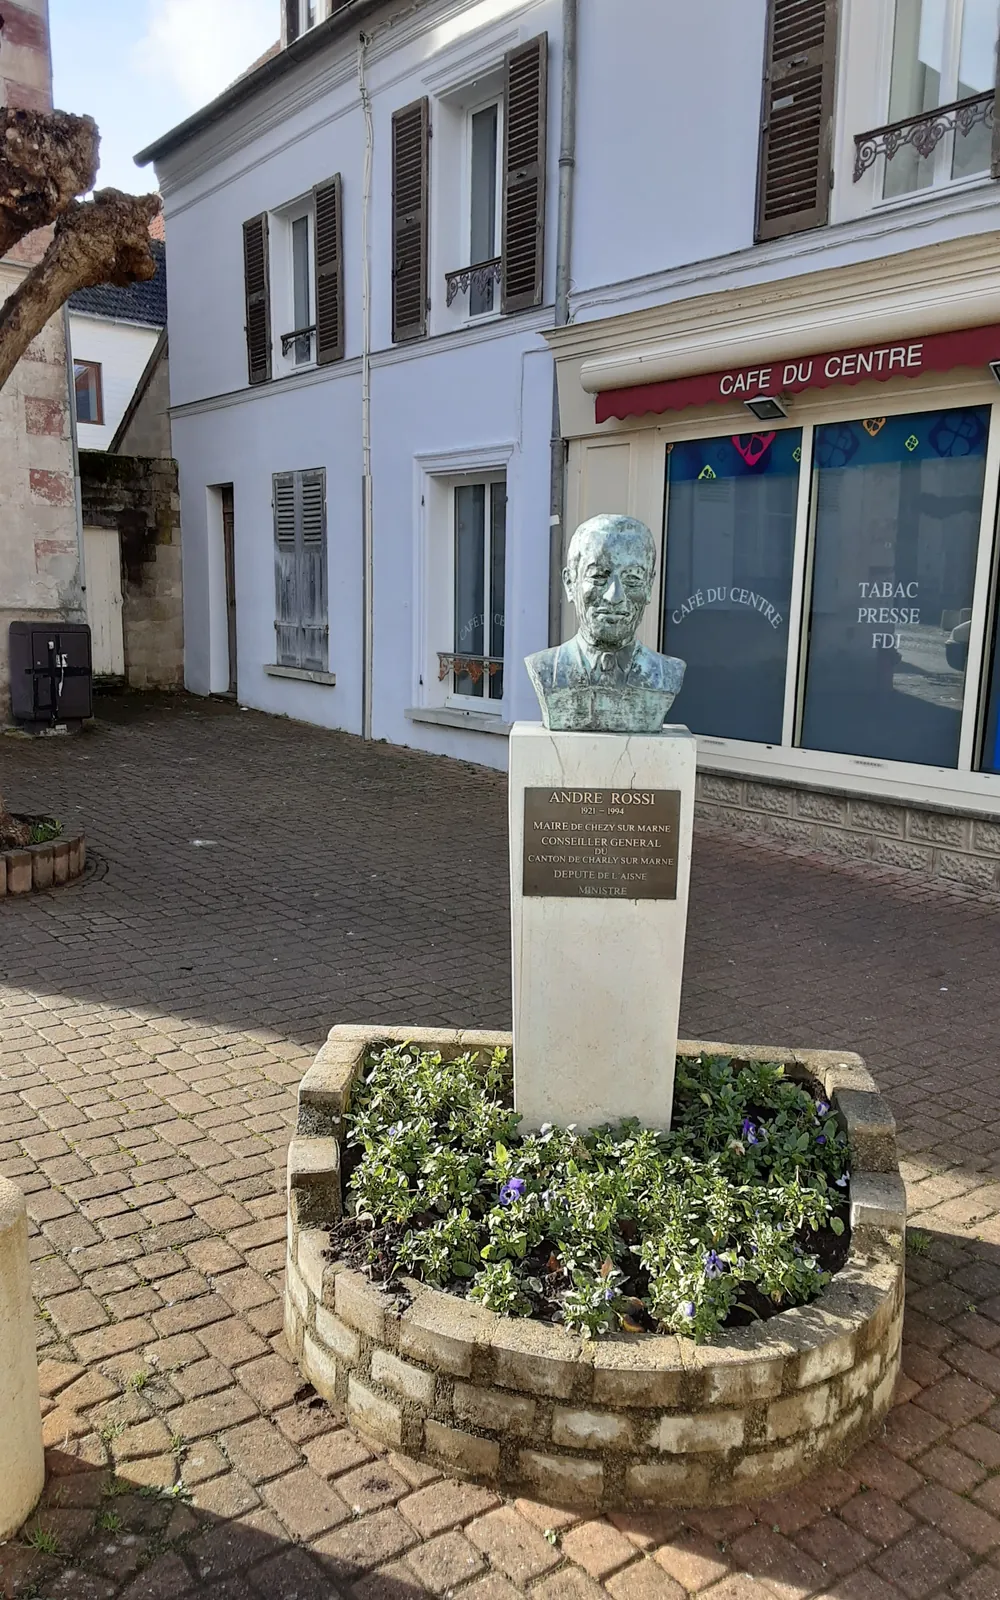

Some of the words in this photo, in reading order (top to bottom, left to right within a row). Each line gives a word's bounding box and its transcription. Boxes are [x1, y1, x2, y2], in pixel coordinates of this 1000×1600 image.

[720, 368, 772, 395] CAFE
[782, 361, 813, 385] DU
[824, 344, 923, 378] CENTRE
[858, 581, 919, 598] TABAC
[671, 588, 705, 625] CAFÉ
[706, 586, 727, 603] DU
[730, 587, 783, 629] CENTRE
[857, 607, 920, 624] PRESSE
[871, 632, 902, 650] FDJ
[549, 791, 603, 803] ANDRE
[611, 792, 655, 805] ROSSI
[580, 807, 596, 815] 1921
[607, 807, 625, 815] 1994
[533, 821, 569, 831] MAIRE
[571, 823, 583, 831] DE
[585, 823, 616, 832] CHEZY
[617, 824, 635, 832] SUR
[637, 824, 671, 833] MARNE
[541, 836, 608, 847] CONSEILLER
[610, 837, 661, 848] GENERAL
[528, 854, 566, 863] CANTON
[568, 855, 580, 864] DE
[582, 856, 619, 865] CHARLY
[621, 856, 639, 865] SUR
[640, 857, 674, 866] MARNE
[554, 869, 595, 880] DEPUTE
[597, 872, 610, 880] DE
[578, 885, 628, 895] MINISTRE
